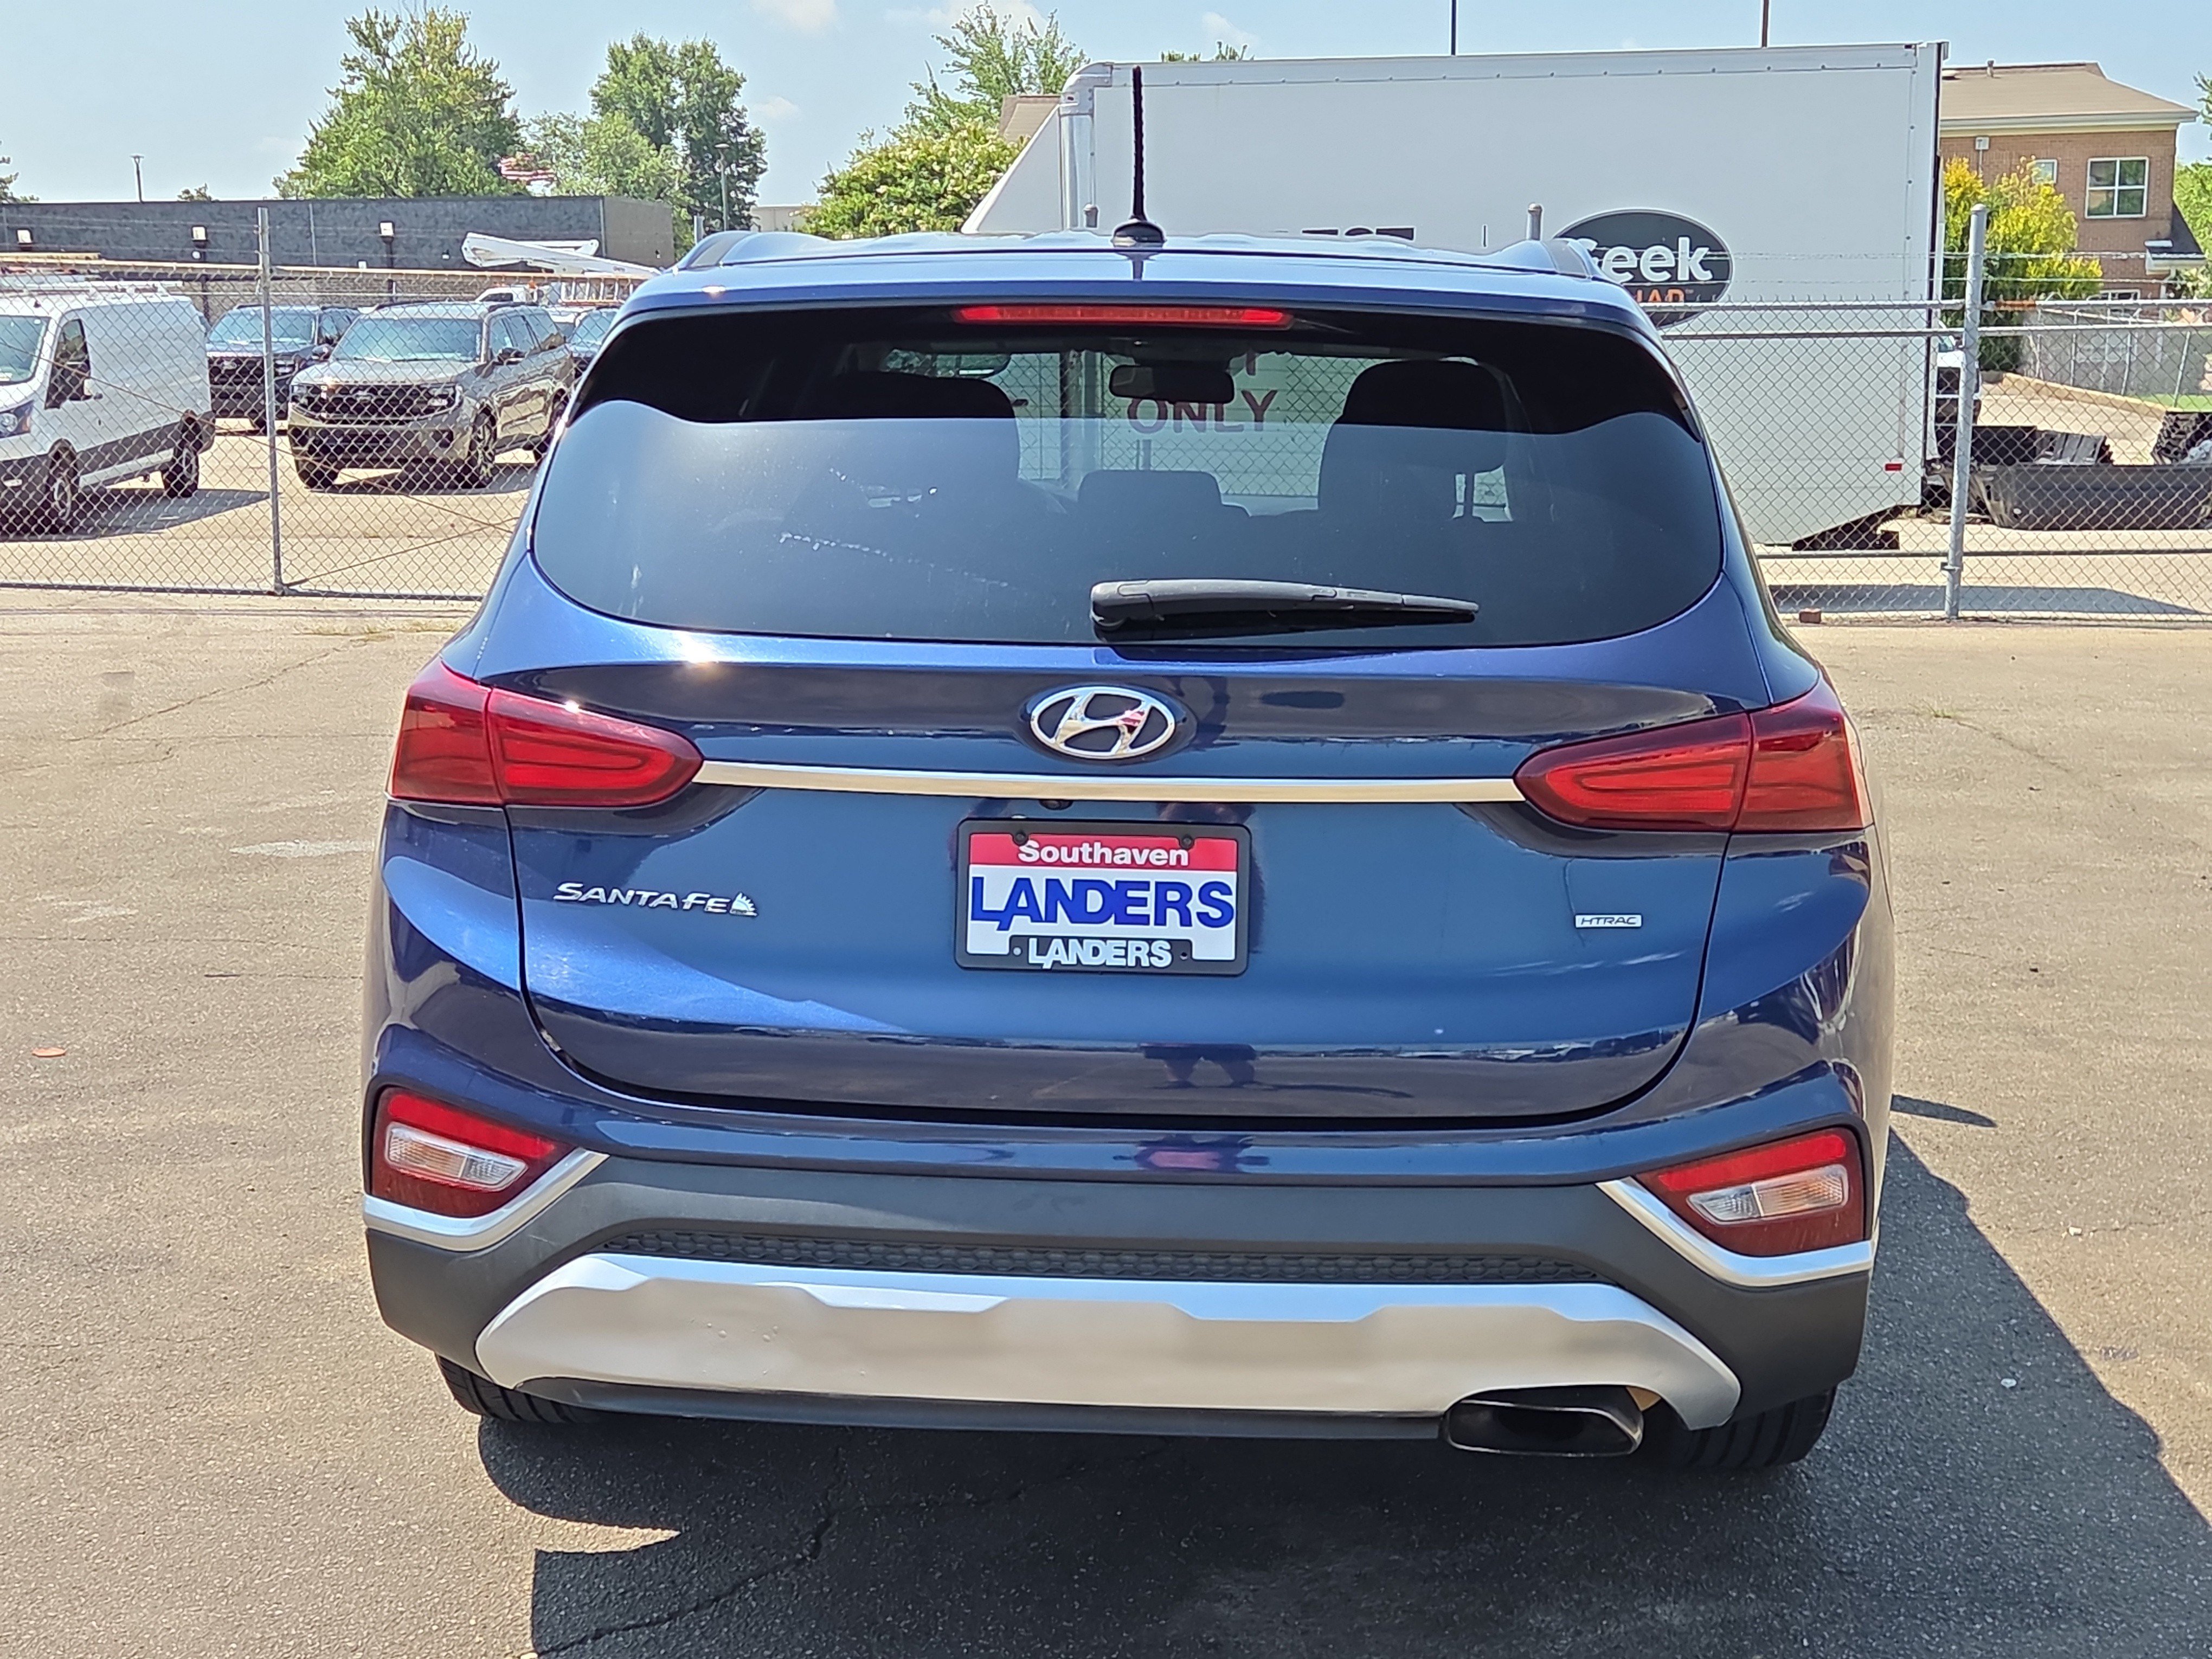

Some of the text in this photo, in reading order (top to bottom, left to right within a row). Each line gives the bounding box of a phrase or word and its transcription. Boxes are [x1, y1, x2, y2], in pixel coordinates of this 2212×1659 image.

[1127, 389, 1278, 434] ONLY
[1018, 840, 1189, 866] Southaven
[970, 876, 1234, 931] LANDERS
[1580, 916, 1637, 925] HTRAC
[1028, 937, 1173, 969] LANDERS
